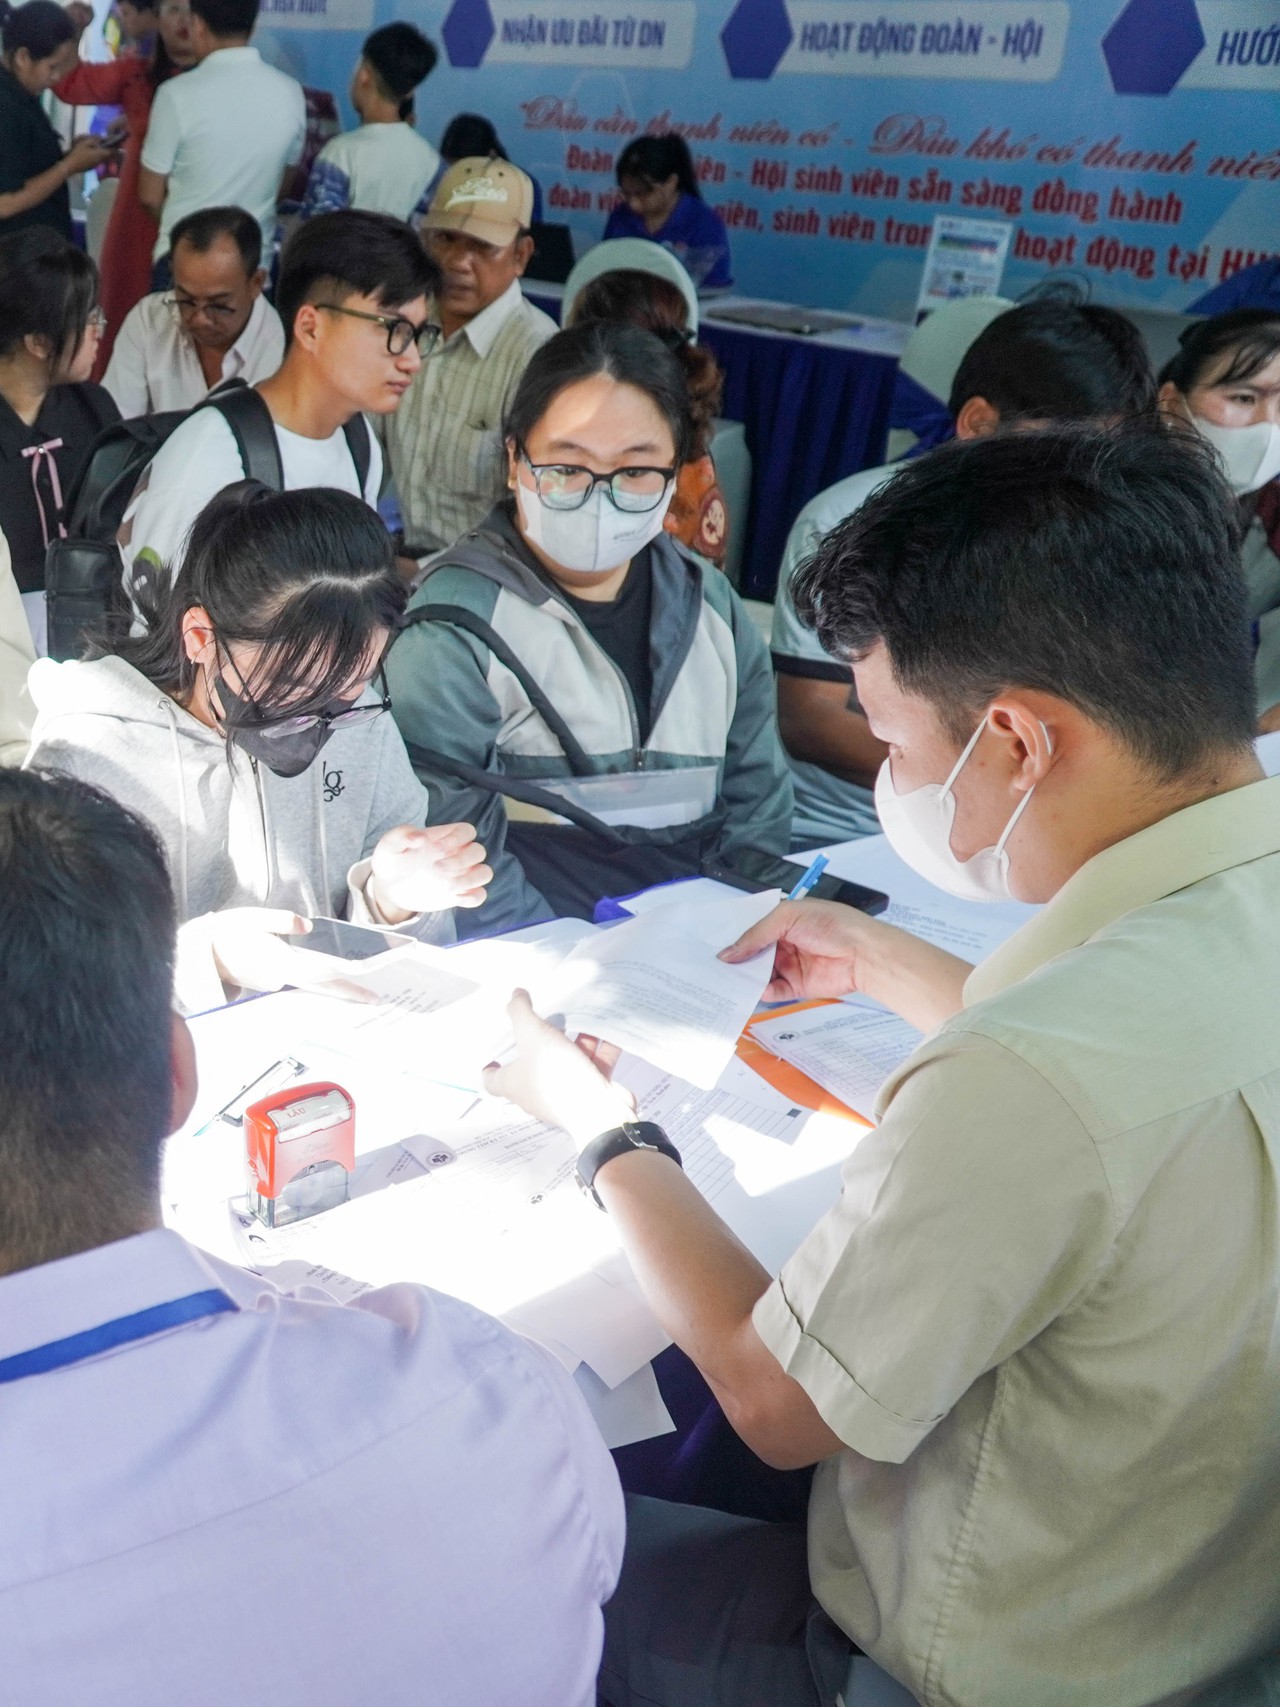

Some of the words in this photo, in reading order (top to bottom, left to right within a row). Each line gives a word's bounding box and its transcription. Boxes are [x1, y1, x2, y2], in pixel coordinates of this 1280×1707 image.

[502, 14, 547, 50] NHẬN
[800, 20, 856, 59] HOẠT
[857, 16, 918, 59] ĐỘNG
[920, 16, 983, 56] ĐOÀN
[1001, 17, 1045, 63] HỘI
[1216, 23, 1280, 66] HƯỚ
[1083, 134, 1198, 175] thanh
[566, 142, 614, 173] Đoàn
[751, 157, 787, 192] Hội
[795, 161, 843, 194] sinh
[851, 166, 900, 198] viên
[908, 166, 952, 204] sẵn
[960, 175, 1023, 217] sàng
[1032, 176, 1099, 224] đồng
[1109, 186, 1183, 224] hành
[549, 182, 592, 210] đoàn
[774, 205, 821, 236] sinh
[828, 210, 876, 242] viên
[885, 215, 933, 248] tron
[1014, 227, 1077, 267] hoạt
[1086, 234, 1156, 280] động
[1167, 243, 1211, 282] tại
